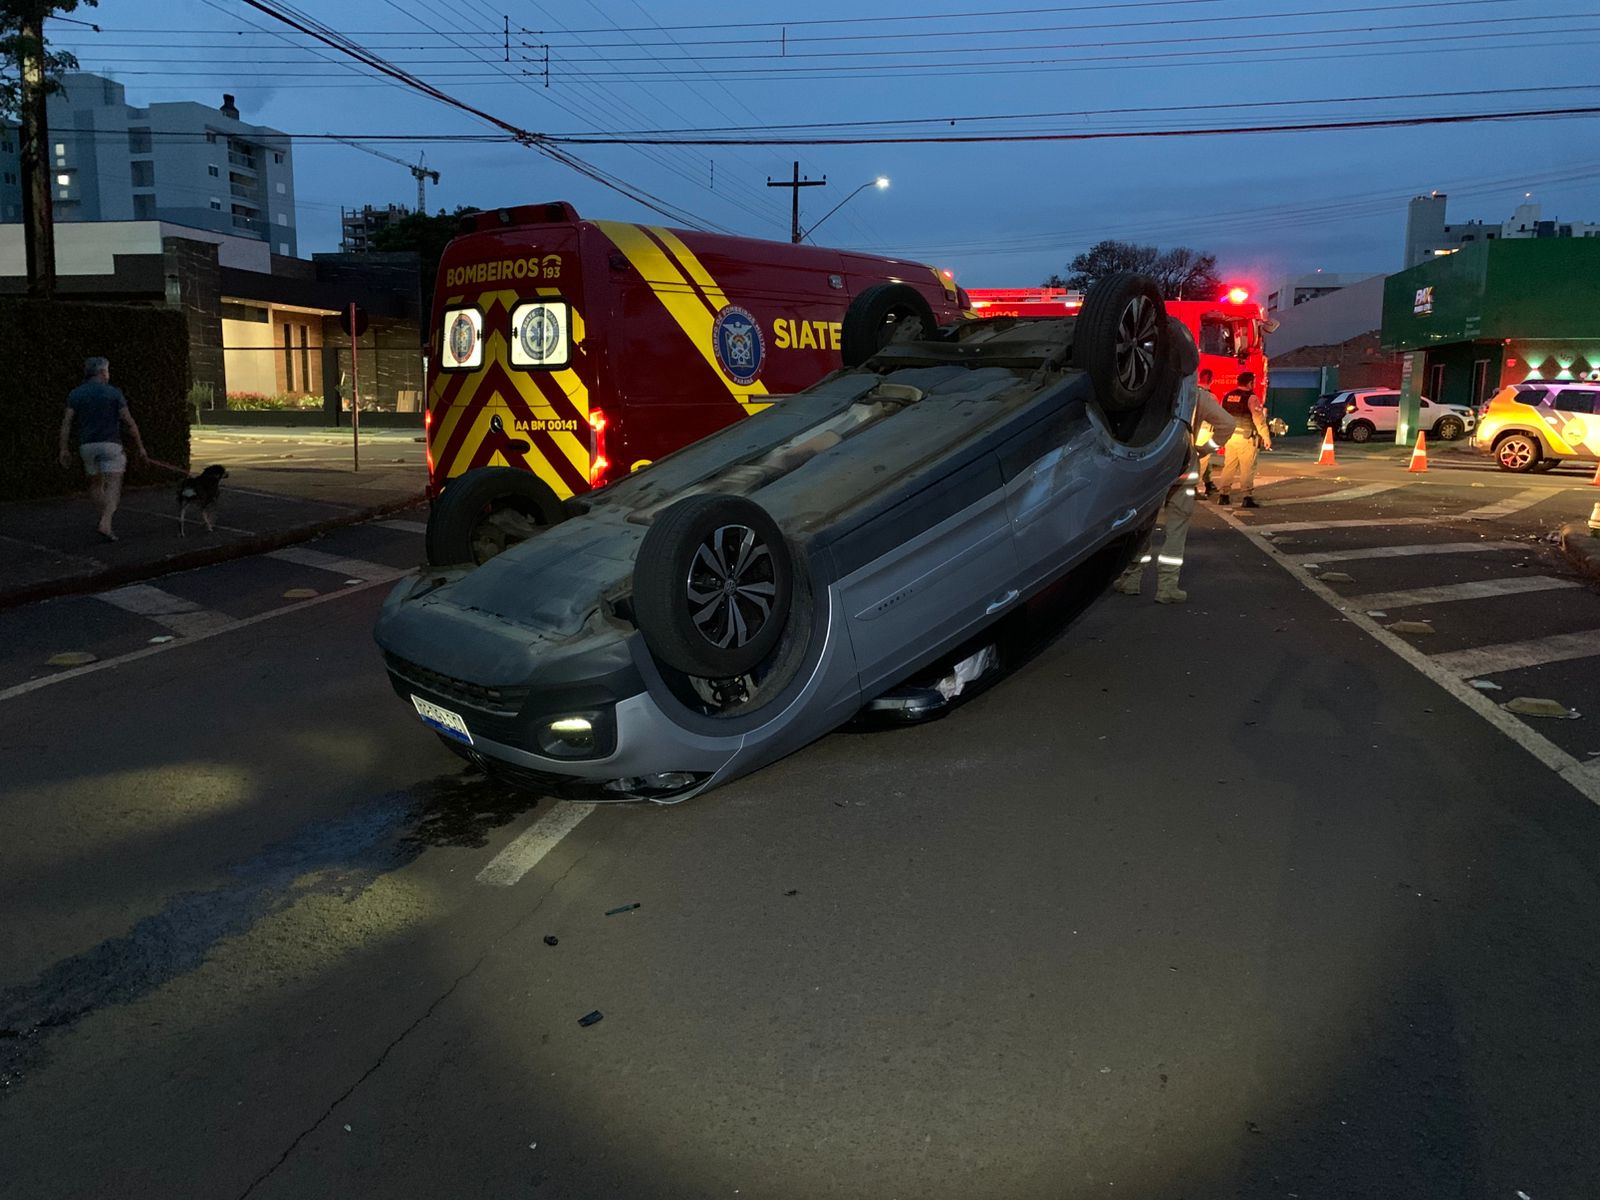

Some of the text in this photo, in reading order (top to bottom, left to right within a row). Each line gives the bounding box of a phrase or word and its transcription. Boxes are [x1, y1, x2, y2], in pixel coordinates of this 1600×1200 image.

[446, 258, 539, 287] BOMBEIROS
[542, 267, 560, 278] 193
[773, 318, 842, 350] SIATE
[515, 419, 578, 431] AA BM 00141
